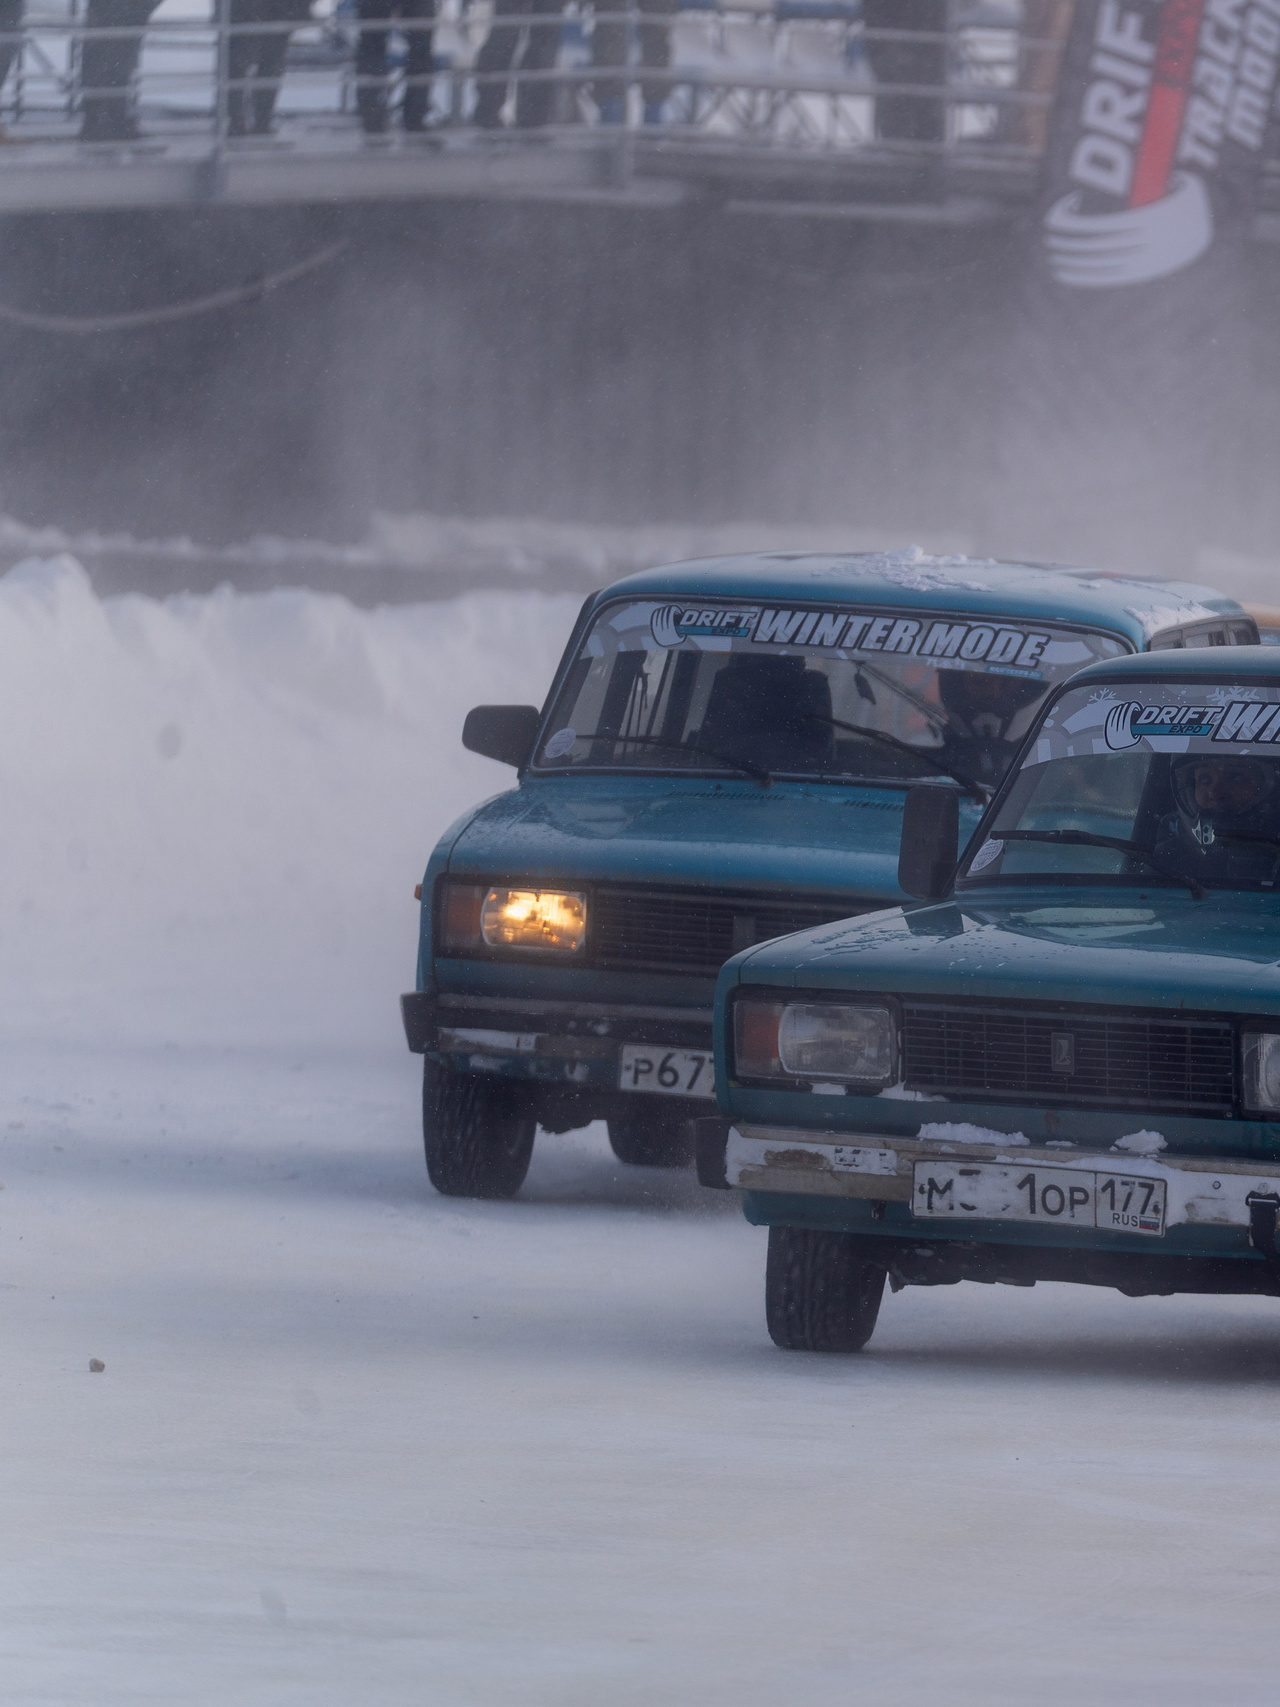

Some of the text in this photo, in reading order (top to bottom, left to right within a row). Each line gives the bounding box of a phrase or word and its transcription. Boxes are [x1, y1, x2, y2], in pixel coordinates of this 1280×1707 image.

[680, 609, 757, 628] DRIFT
[753, 608, 1050, 668] WINTER MODE
[1136, 706, 1224, 724] DRIFT
[1169, 725, 1202, 734] EXPO
[1101, 1178, 1155, 1215] 177
[1112, 1212, 1138, 1227] RUS
